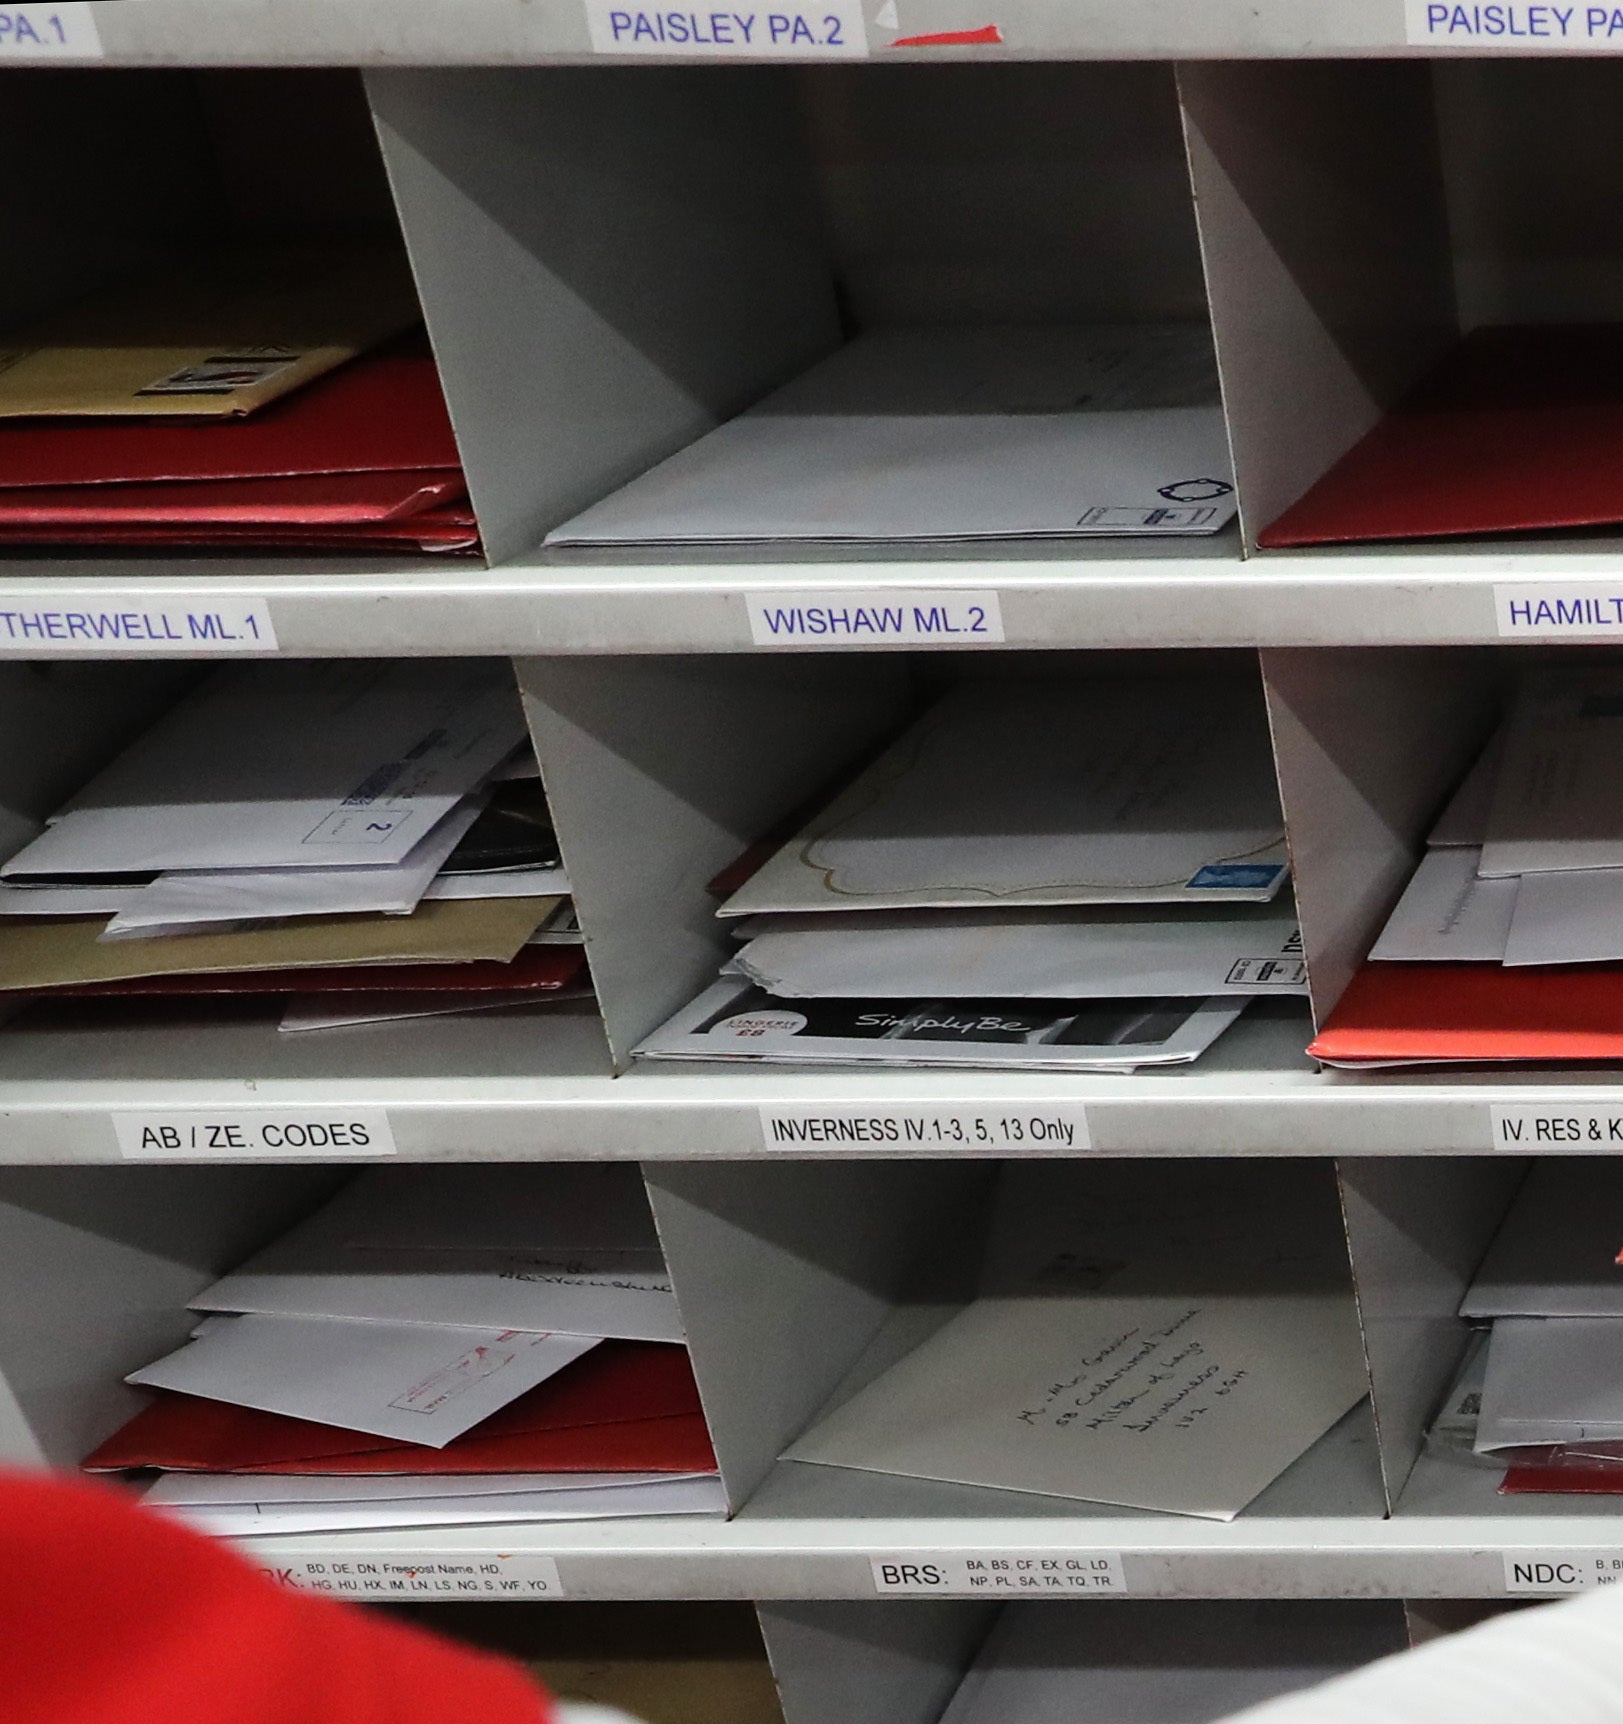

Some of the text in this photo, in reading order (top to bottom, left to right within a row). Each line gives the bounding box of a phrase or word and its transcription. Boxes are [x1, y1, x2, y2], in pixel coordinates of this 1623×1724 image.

[610, 11, 844, 45] PAISLEY PA.2
[1427, 4, 1574, 36] PAISLEY
[1, 612, 259, 640] THERWELL ML.1
[763, 606, 987, 634] WISHAW ML.2
[142, 1126, 181, 1149] AB
[204, 1125, 253, 1148] ZE.
[262, 1123, 370, 1148] CODES
[771, 1117, 1074, 1146] INVERNESS IV.1-3, 5, 13 Only
[1502, 1119, 1529, 1141] IV.
[1535, 1118, 1581, 1141] RES
[1588, 1118, 1602, 1141] &
[881, 1564, 948, 1585] BRS:
[1514, 1563, 1583, 1584] NDC:
